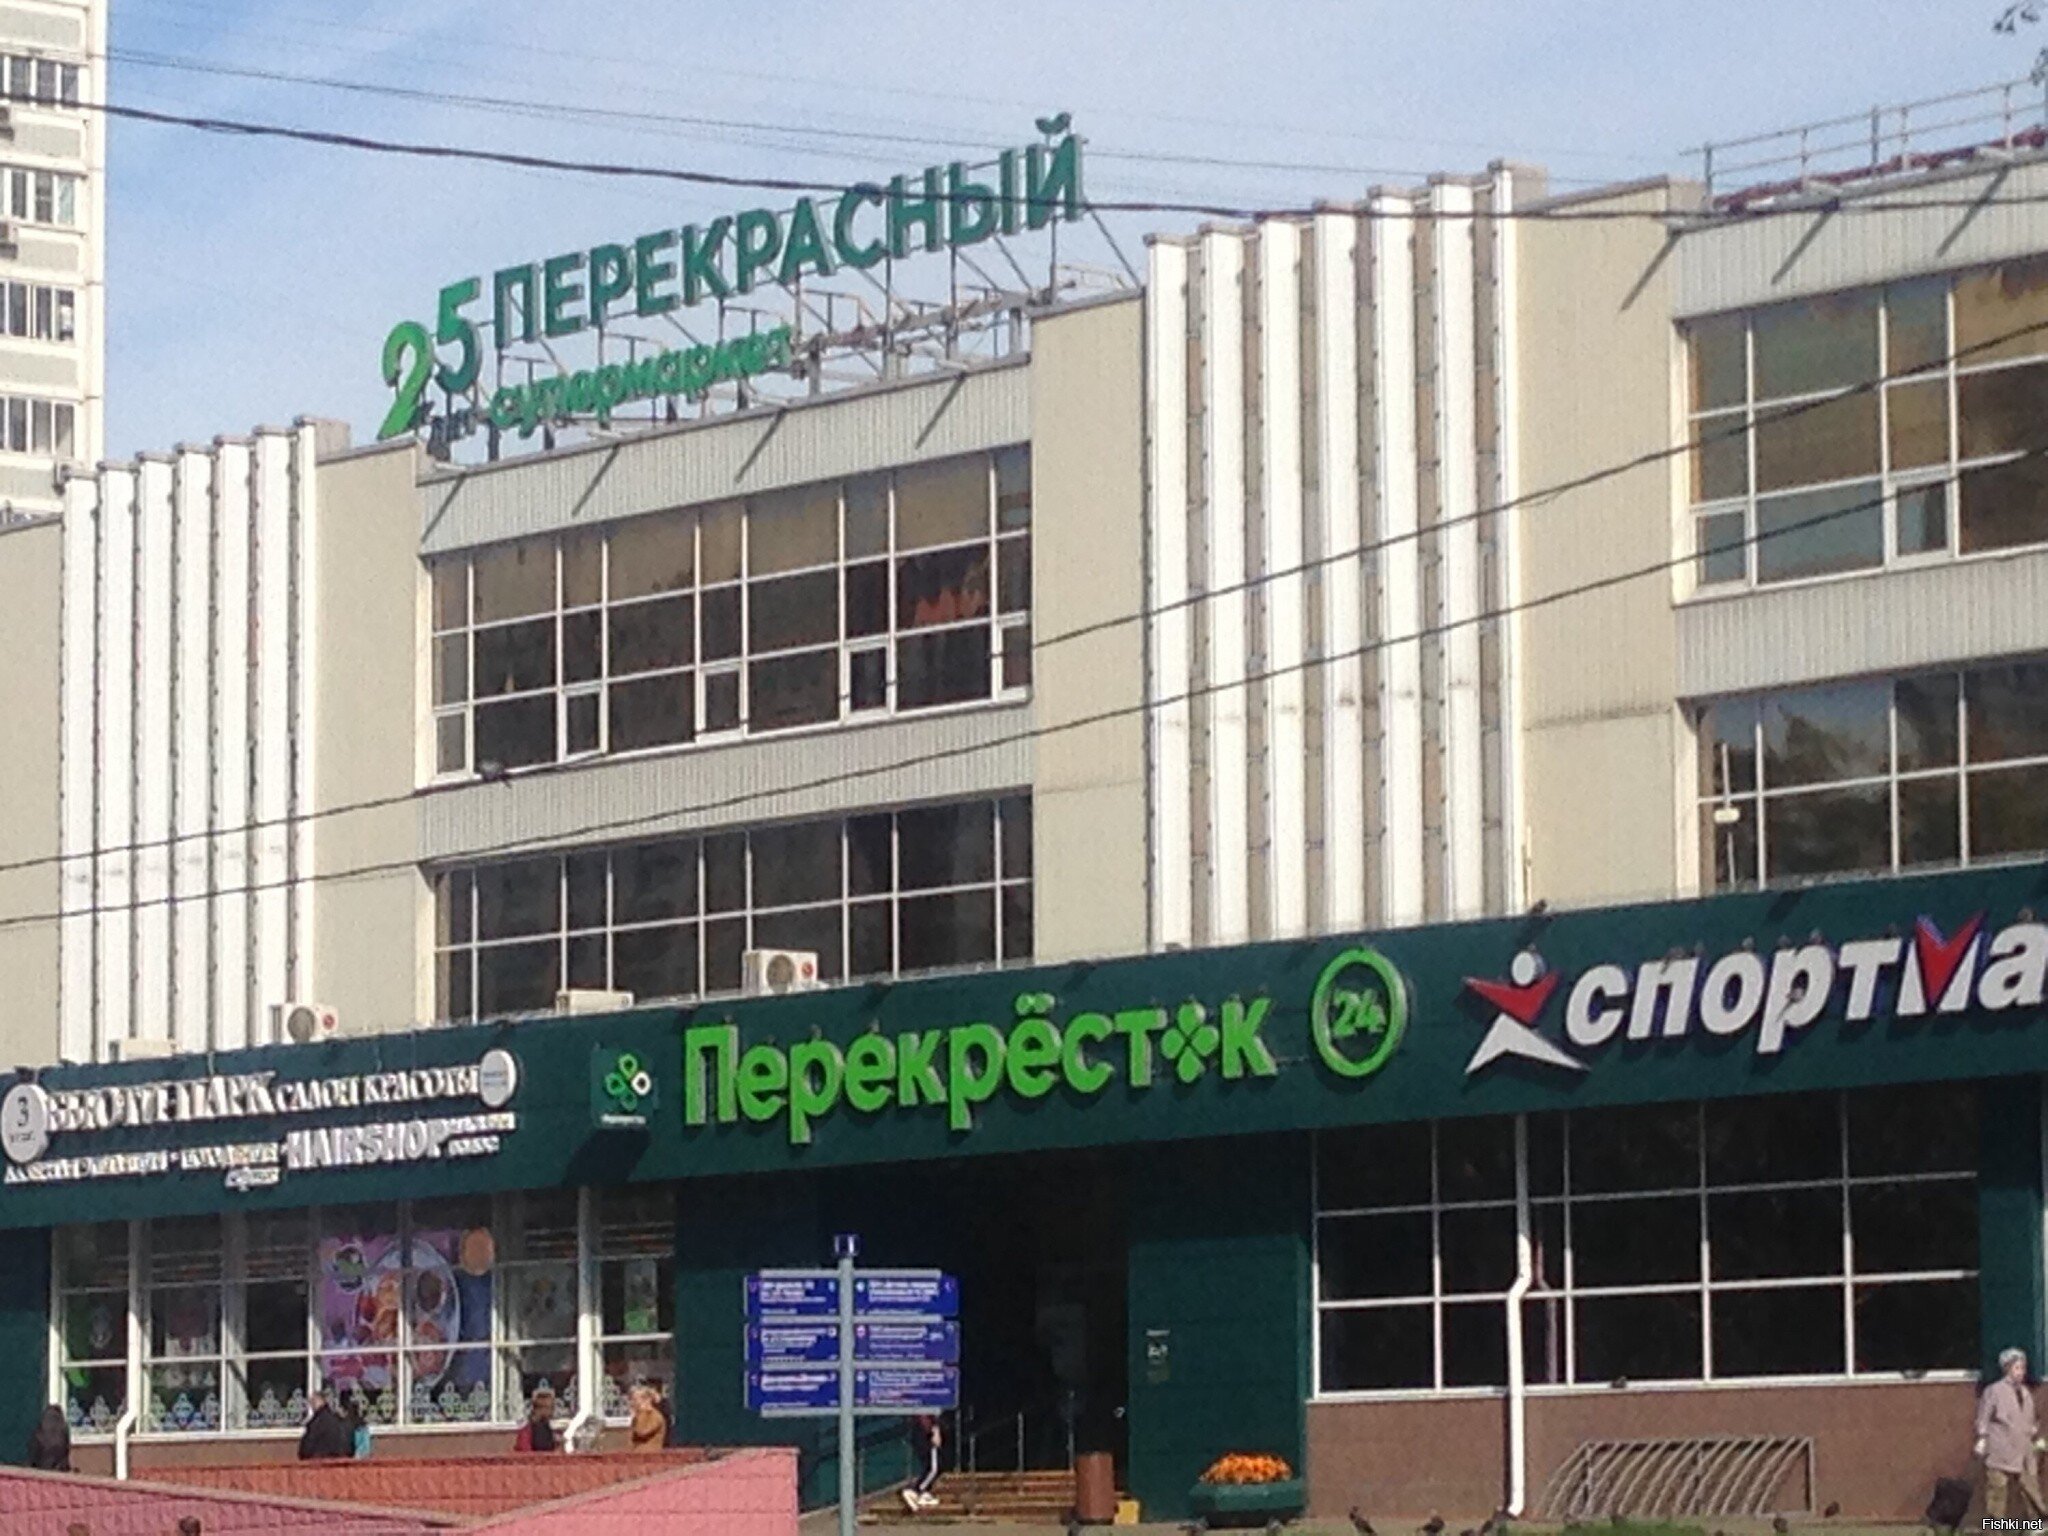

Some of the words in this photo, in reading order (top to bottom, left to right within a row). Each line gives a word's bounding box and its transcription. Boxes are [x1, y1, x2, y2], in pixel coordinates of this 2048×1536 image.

[376, 277, 481, 440] 25
[493, 112, 1087, 349] ПЕРЕКРАСНЫЙ
[1333, 988, 1387, 1036] 24
